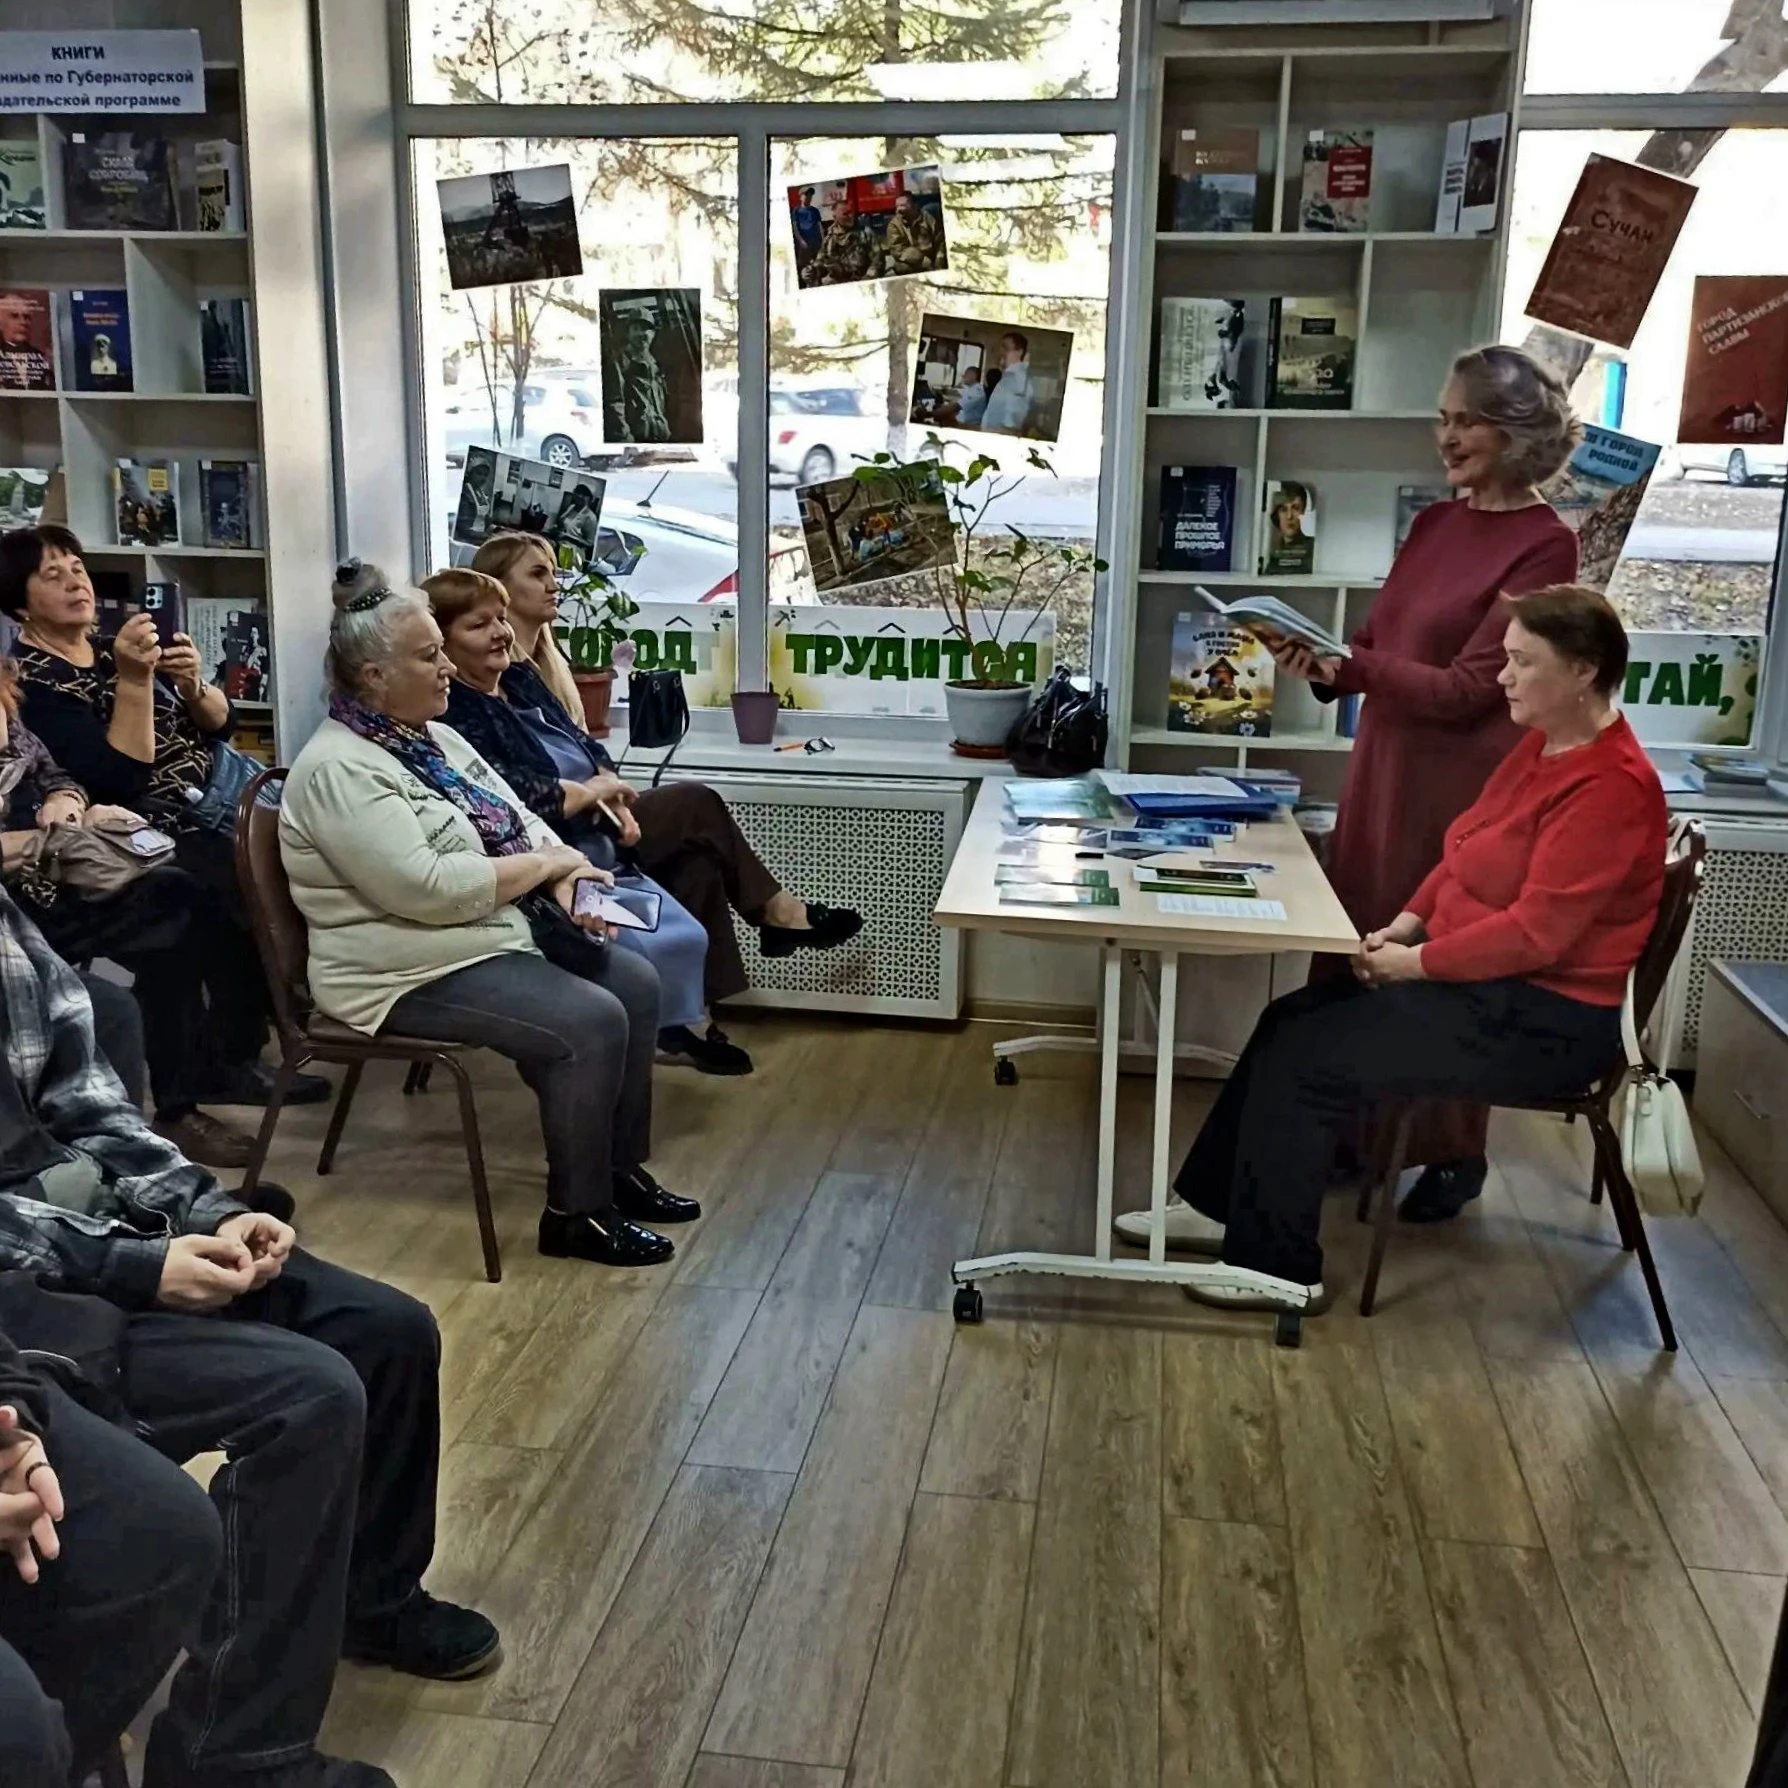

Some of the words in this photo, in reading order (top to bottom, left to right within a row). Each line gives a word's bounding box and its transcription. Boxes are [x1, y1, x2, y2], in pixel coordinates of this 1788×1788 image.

[52, 46, 104, 60] КНИГИ
[45, 76, 63, 84] по
[67, 70, 194, 87] Губернаторской
[95, 98, 181, 108] программе
[1697, 307, 1737, 333] ГОРОД
[1708, 328, 1750, 355] СЛАВЫ
[1601, 435, 1644, 458] ГОРОД
[1588, 448, 1639, 472] РОДНОЙ
[785, 633, 1037, 682] ТРУДИТСЯ
